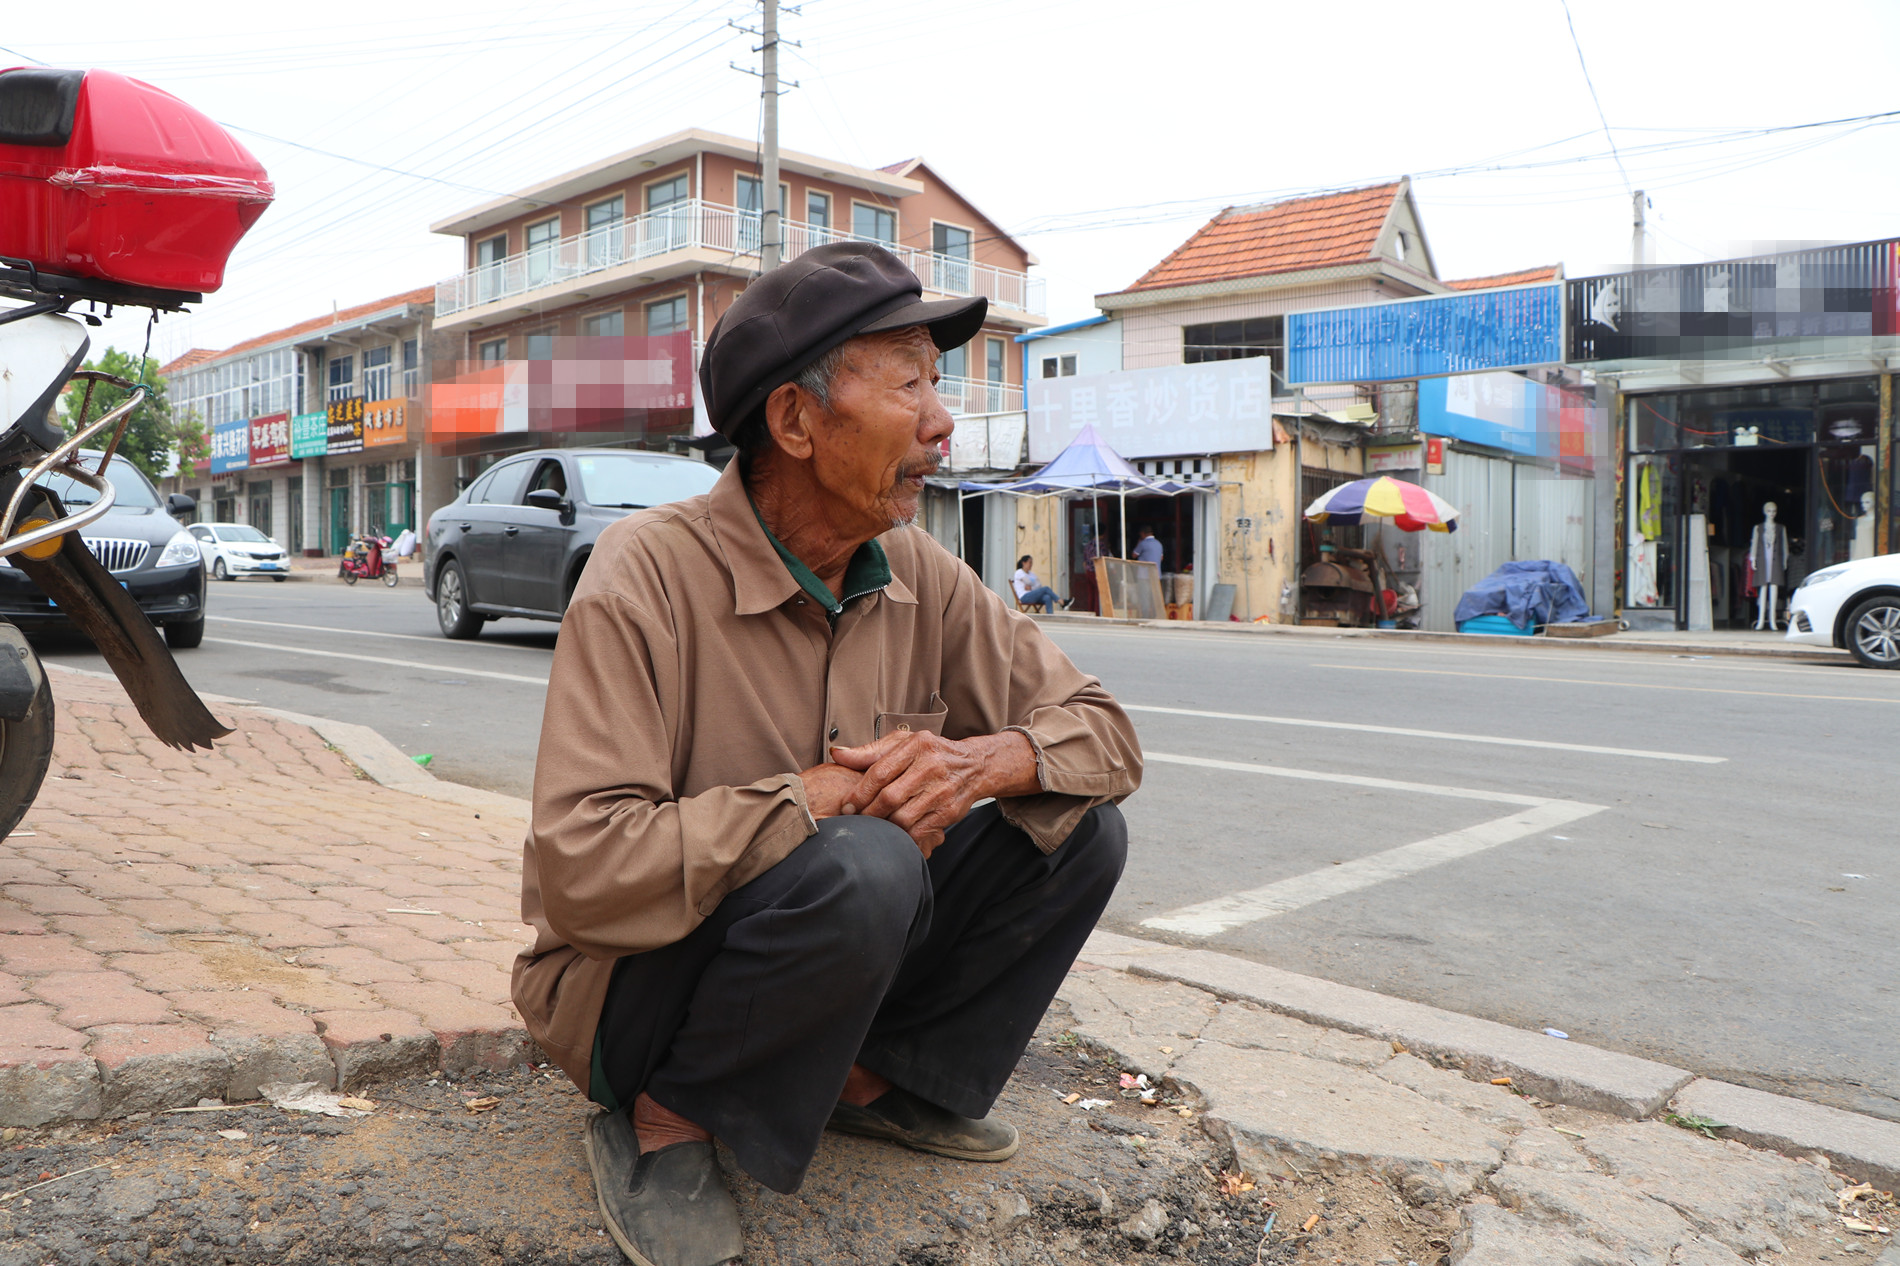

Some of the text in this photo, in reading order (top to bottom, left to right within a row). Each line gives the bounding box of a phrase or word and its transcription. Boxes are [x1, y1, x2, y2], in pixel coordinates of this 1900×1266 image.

[1033, 374, 1263, 433] 十里香炒货店
